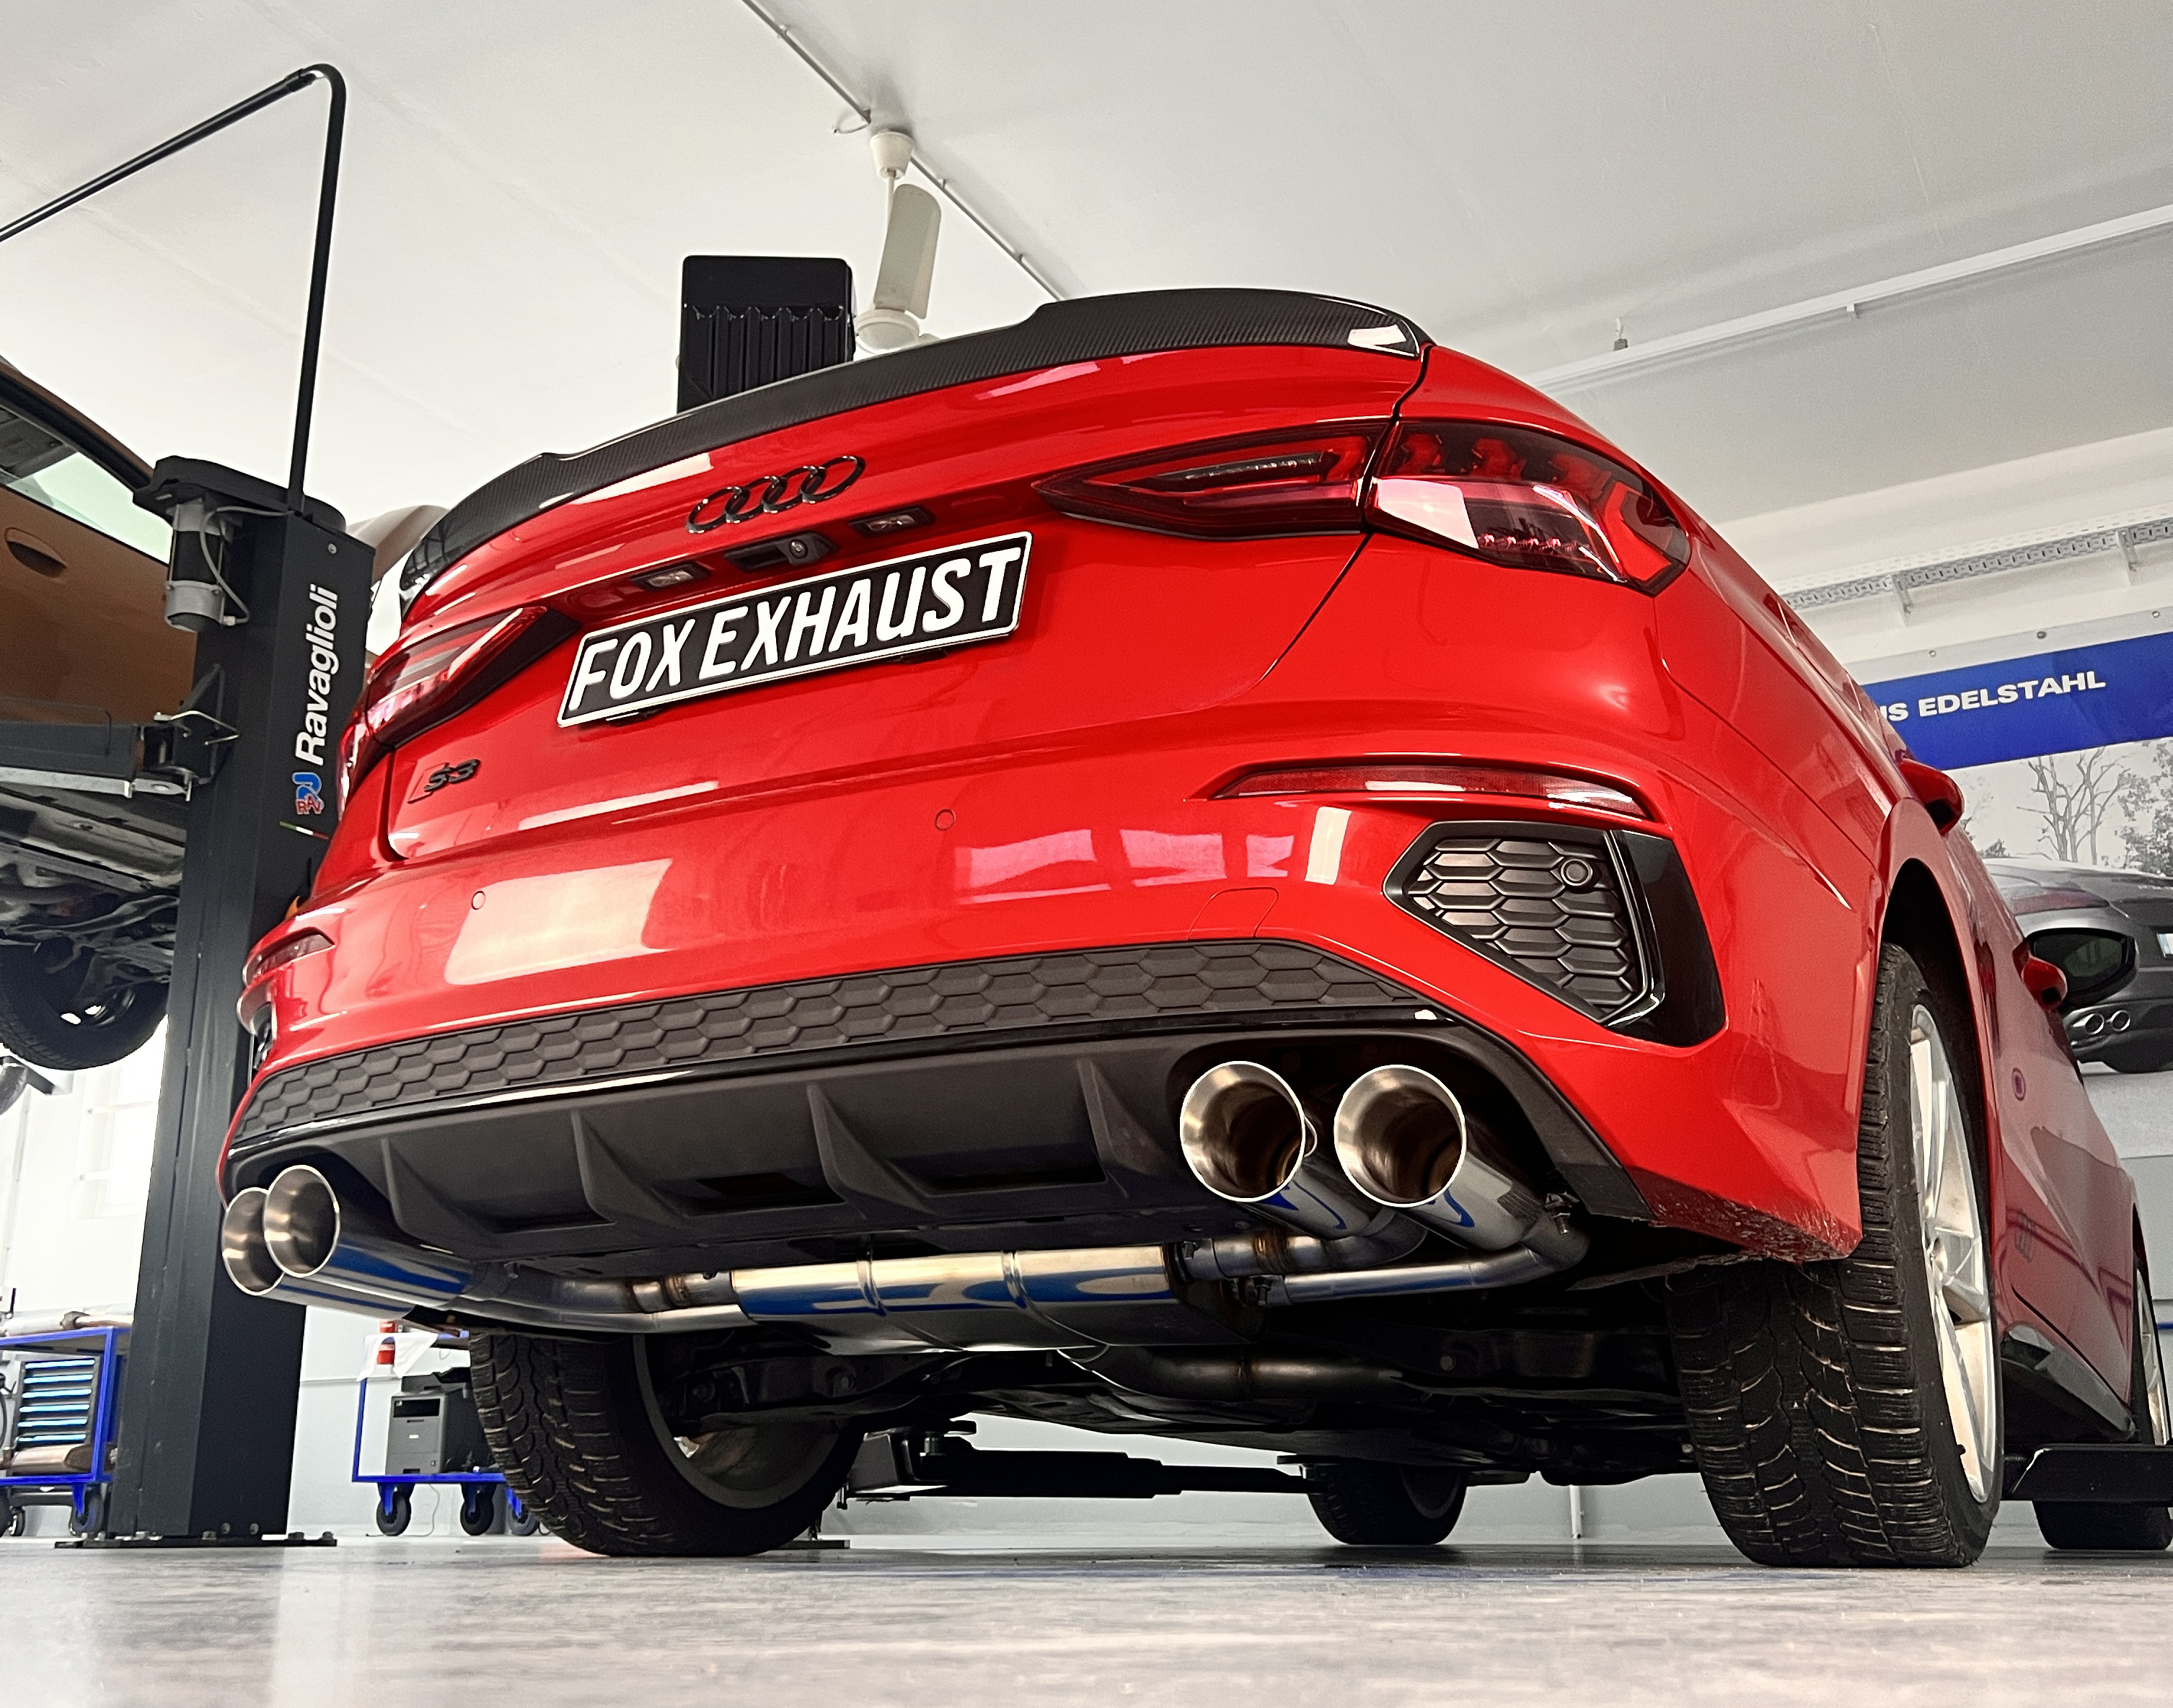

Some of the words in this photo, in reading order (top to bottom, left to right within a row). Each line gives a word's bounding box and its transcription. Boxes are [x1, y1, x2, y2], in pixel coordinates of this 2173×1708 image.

[295, 583, 340, 766] Ravaglioli
[568, 618, 696, 712] FOX
[698, 546, 1022, 682] EXHAUST
[1918, 670, 2107, 718] EDELSTAHL
[423, 758, 481, 793] S3
